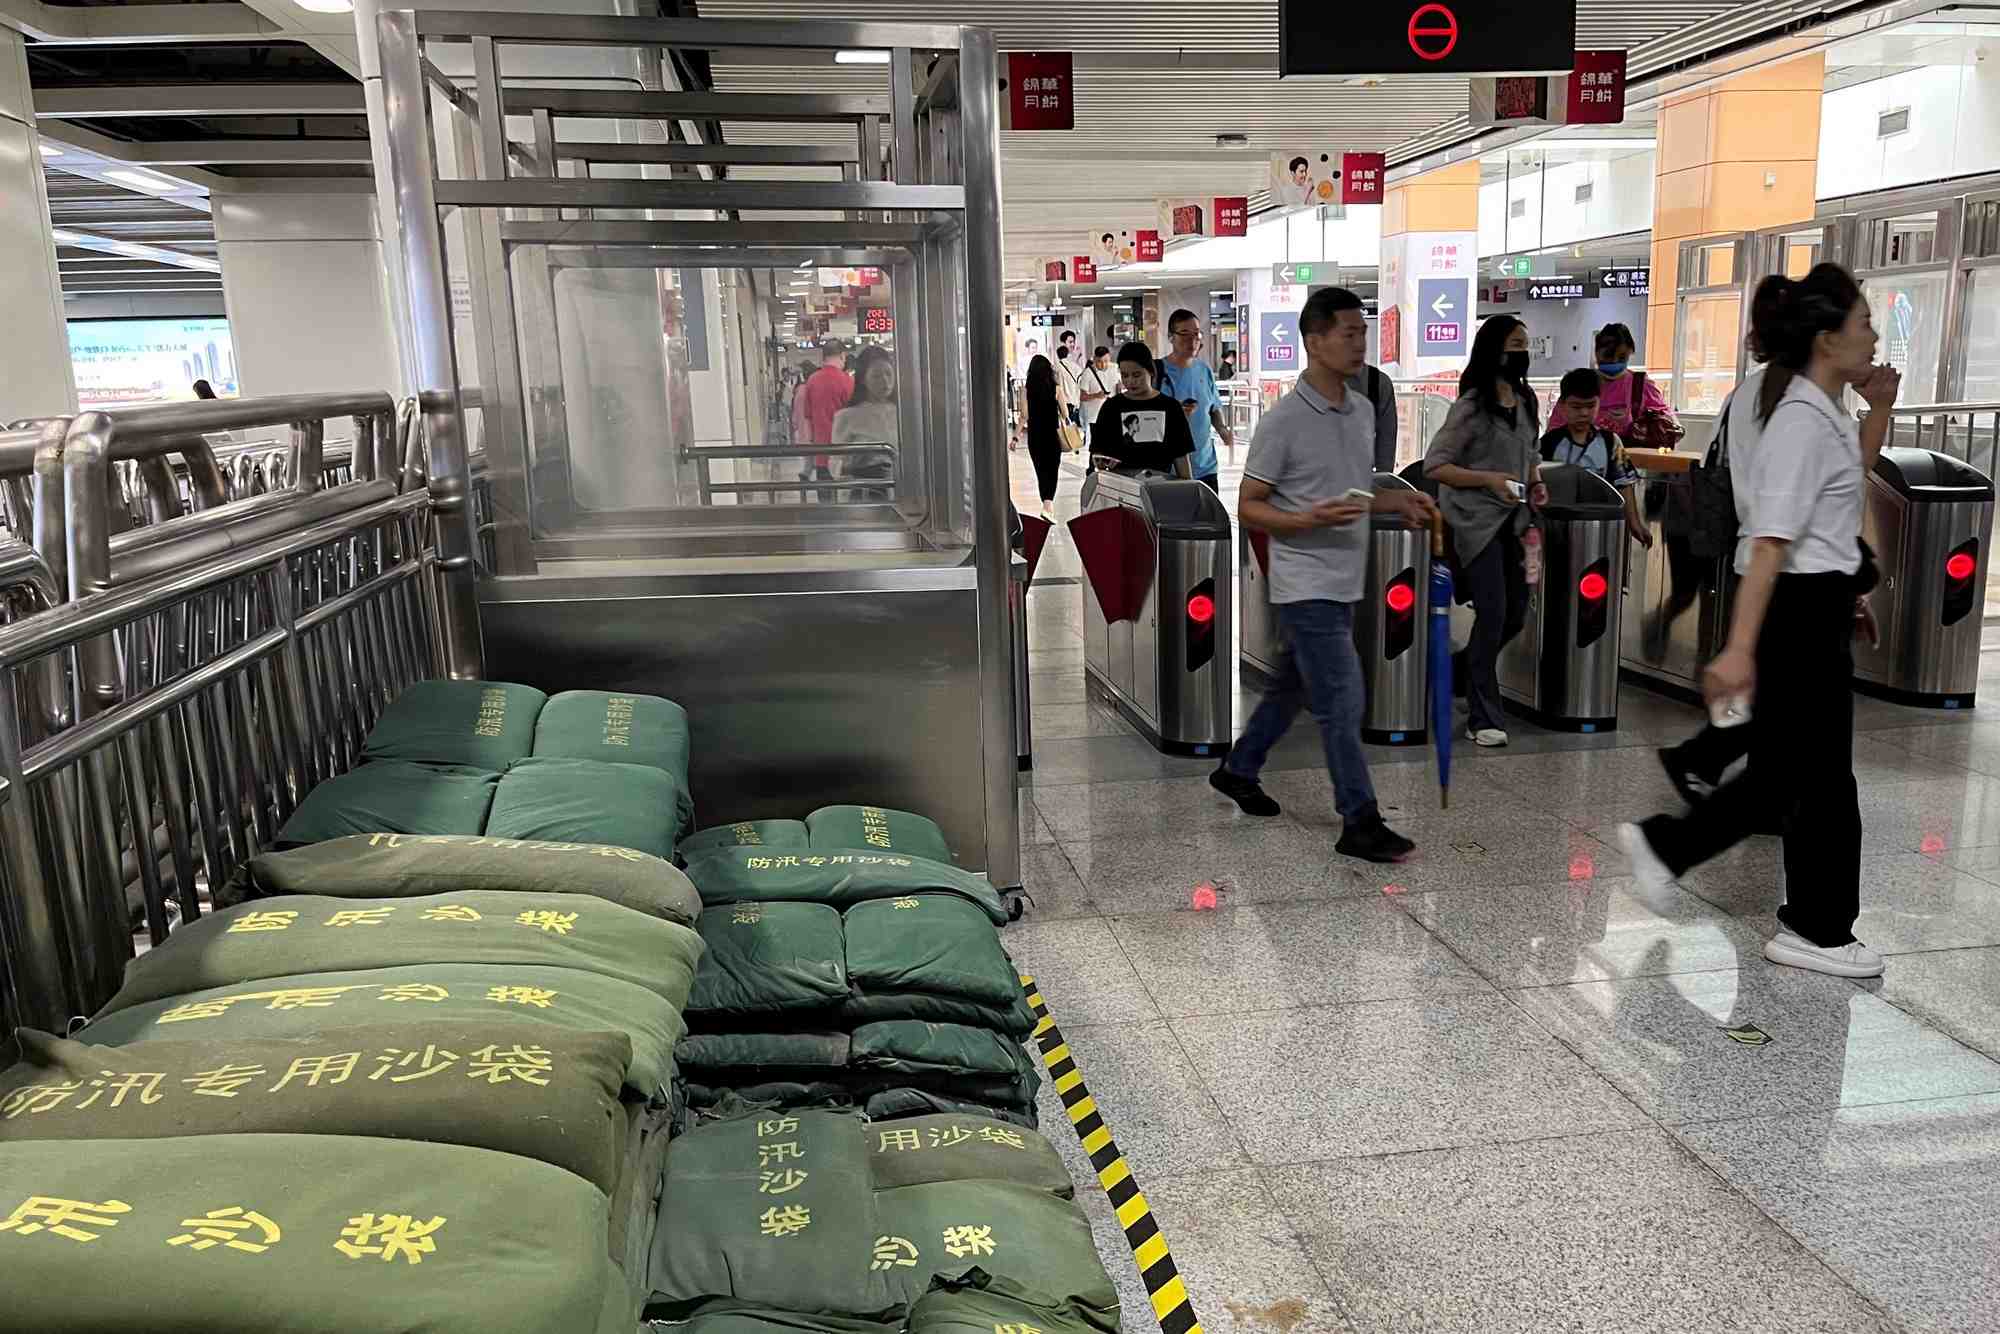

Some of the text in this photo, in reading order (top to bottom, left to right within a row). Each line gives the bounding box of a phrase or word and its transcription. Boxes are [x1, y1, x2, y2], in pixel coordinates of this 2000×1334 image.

[865, 318, 894, 330] 12:33
[2, 1043, 553, 1119] 防汛专用沙袋
[757, 1116, 811, 1238] 防汛沙袋
[871, 1223, 999, 1271] 沙袋
